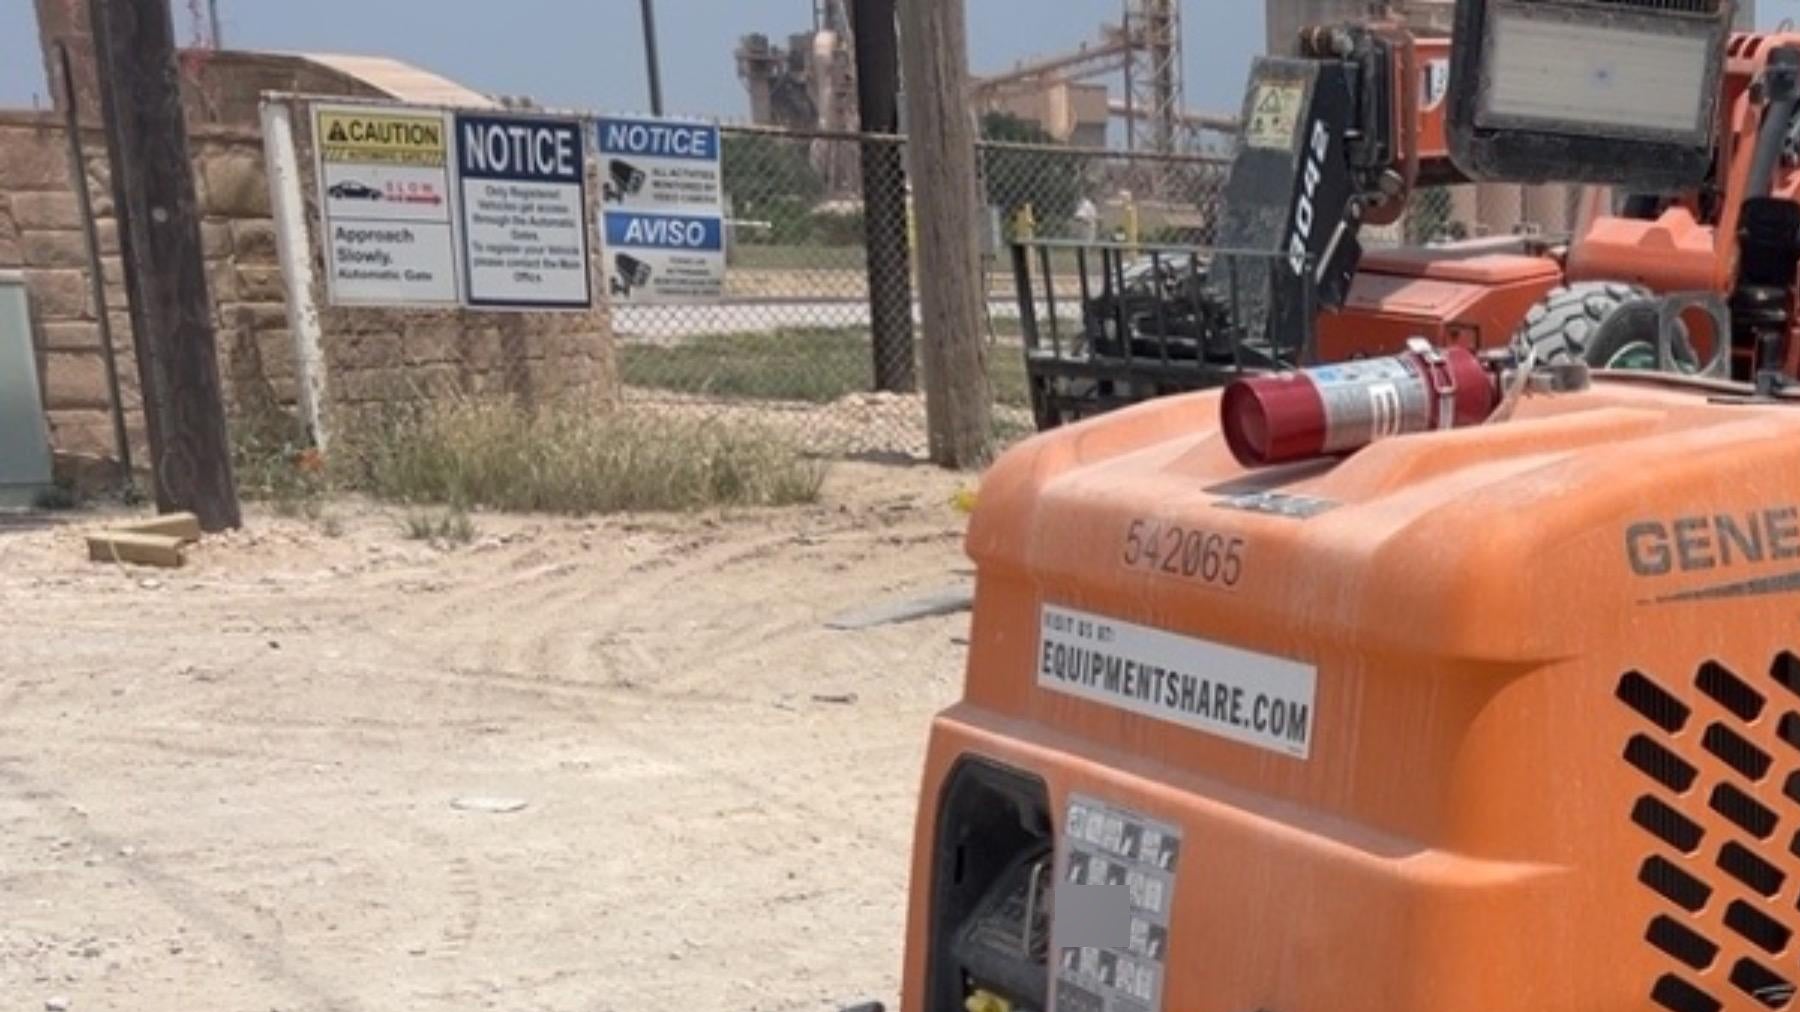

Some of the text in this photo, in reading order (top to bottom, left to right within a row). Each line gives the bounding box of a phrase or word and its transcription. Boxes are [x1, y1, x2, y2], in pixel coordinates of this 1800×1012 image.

[348, 119, 439, 144] CAUTION
[606, 124, 709, 156] NOTICE
[464, 122, 574, 175] NOTICE
[335, 226, 415, 243] Approach
[623, 217, 706, 247] AVISO
[336, 248, 393, 266] Slowly.
[1123, 519, 1244, 586] 542065
[1041, 640, 1308, 743] EQUIPMENTSHARE.COM
